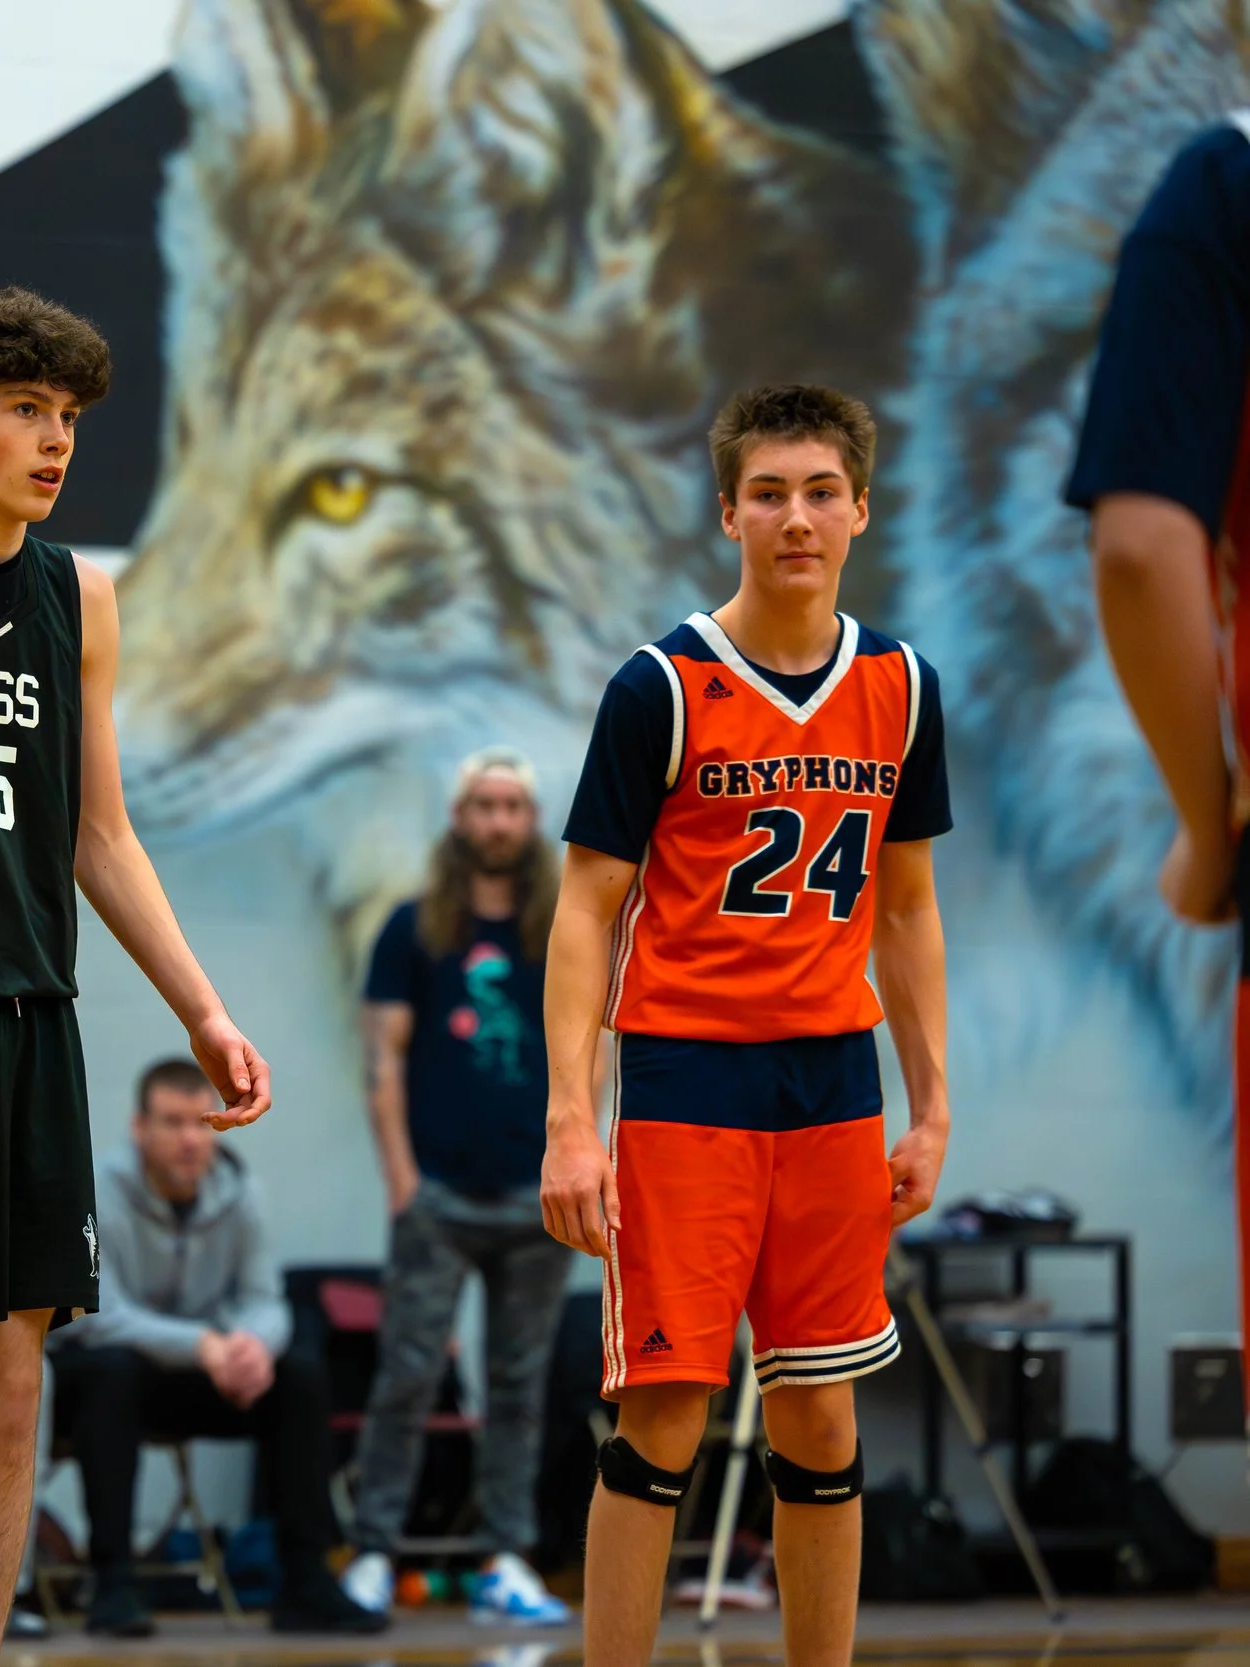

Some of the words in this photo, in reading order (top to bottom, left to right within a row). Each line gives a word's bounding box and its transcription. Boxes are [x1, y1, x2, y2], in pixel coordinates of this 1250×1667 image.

[697, 755, 899, 798] GRYPHONS
[718, 806, 872, 922] 24
[640, 1343, 672, 1354] adidas
